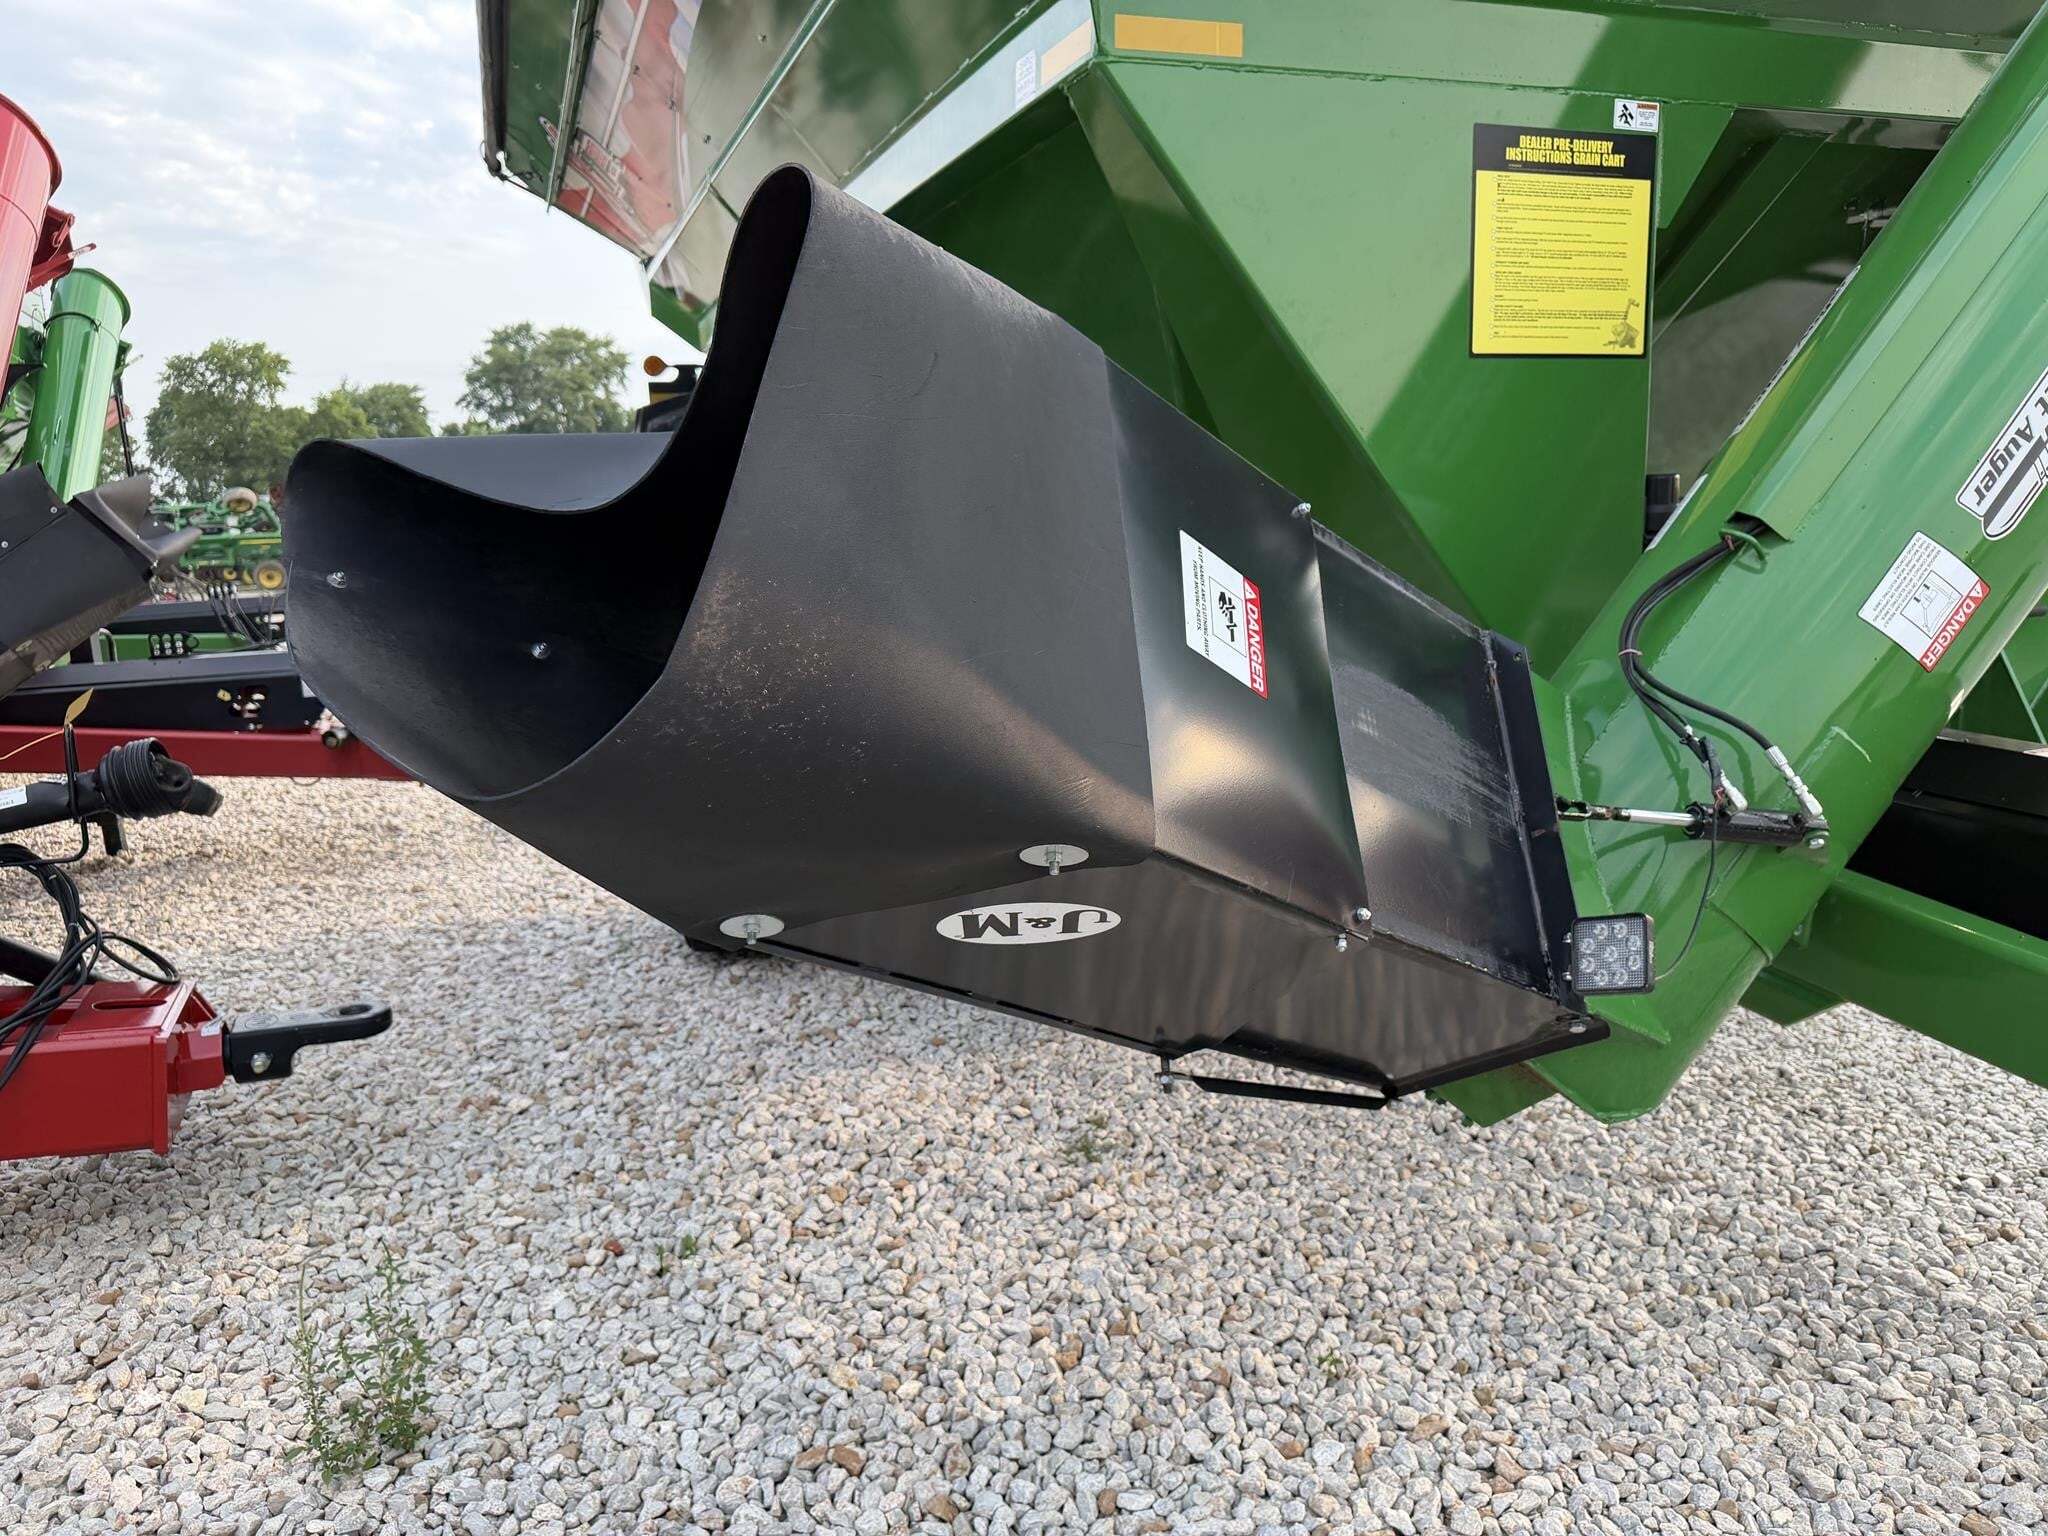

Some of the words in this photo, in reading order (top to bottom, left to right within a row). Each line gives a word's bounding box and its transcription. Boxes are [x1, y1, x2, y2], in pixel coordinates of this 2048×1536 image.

[1505, 146, 1573, 165] INSTRUCTIONS
[1573, 151, 1601, 166] GRAIN
[1602, 154, 1627, 168] CART
[1519, 134, 1552, 149] DEALER
[1553, 137, 1614, 154] PRE-DELIVERY
[1972, 415, 2034, 506] Auger
[1246, 604, 1264, 692] DANGER
[1922, 599, 1975, 667] DANGER
[957, 909, 1111, 939] J&M
